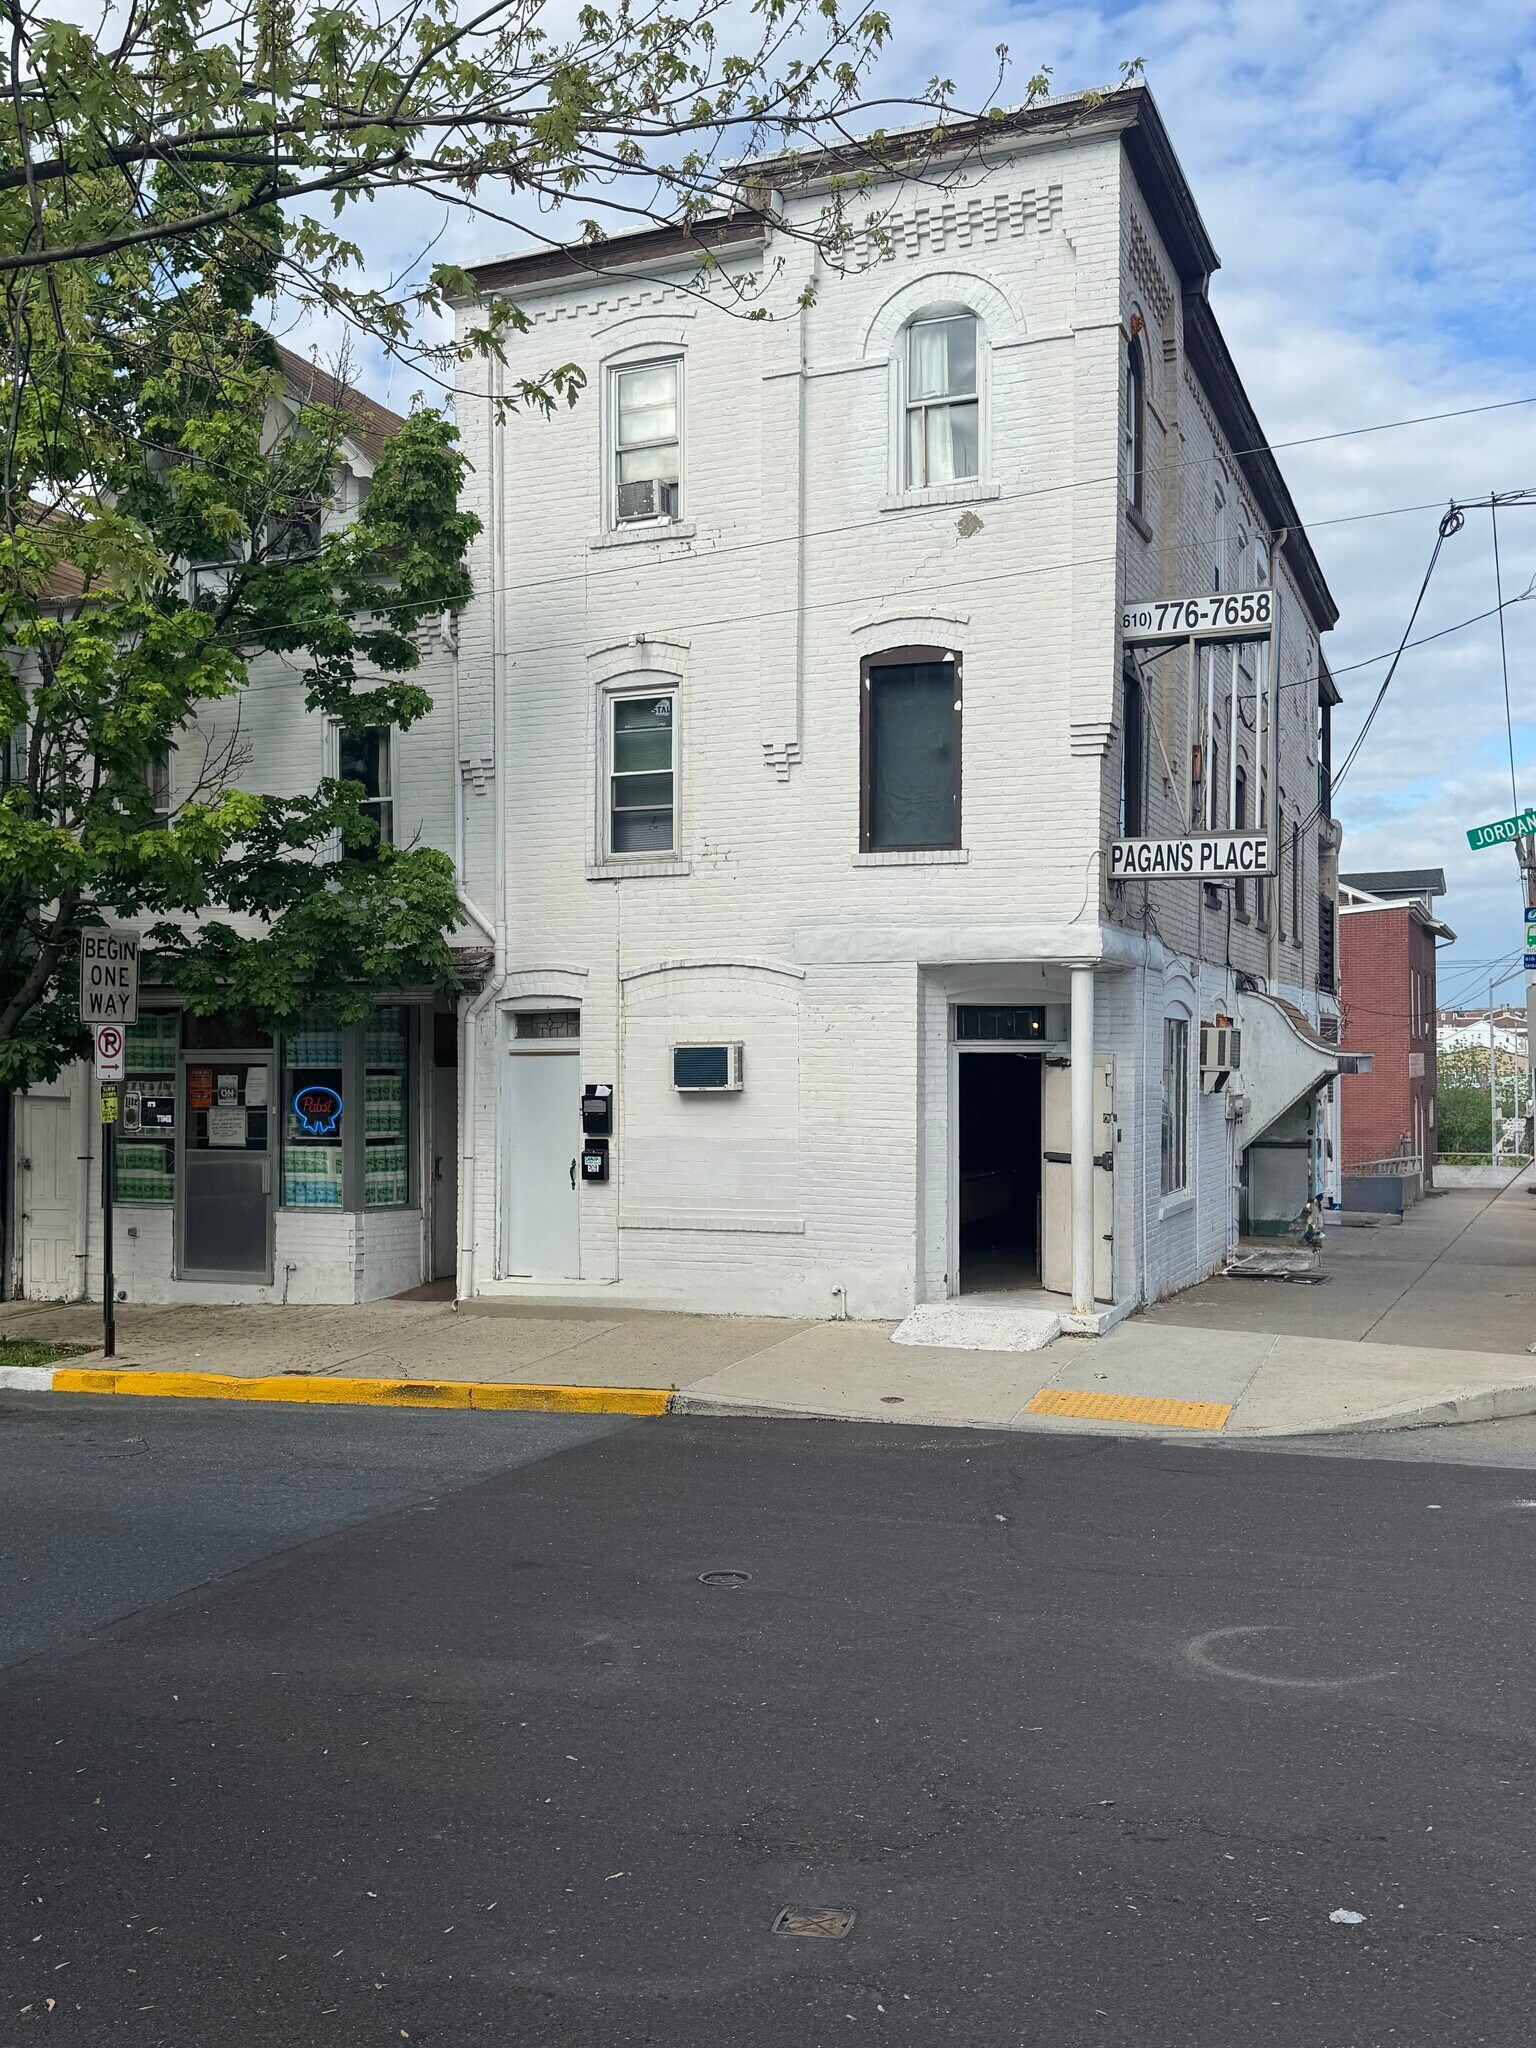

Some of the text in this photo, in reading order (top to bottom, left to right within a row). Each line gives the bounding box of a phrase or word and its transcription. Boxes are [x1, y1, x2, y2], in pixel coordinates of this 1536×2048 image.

[1155, 593, 1271, 631] 776-7658
[1112, 840, 1267, 873] PAGAN'S PLACE
[85, 936, 136, 961] BEGIN
[91, 965, 130, 988] ONE
[89, 992, 131, 1015] WAY
[220, 1089, 234, 1097] ON
[302, 1096, 334, 1113] Pabst
[156, 1114, 172, 1123] TIME
